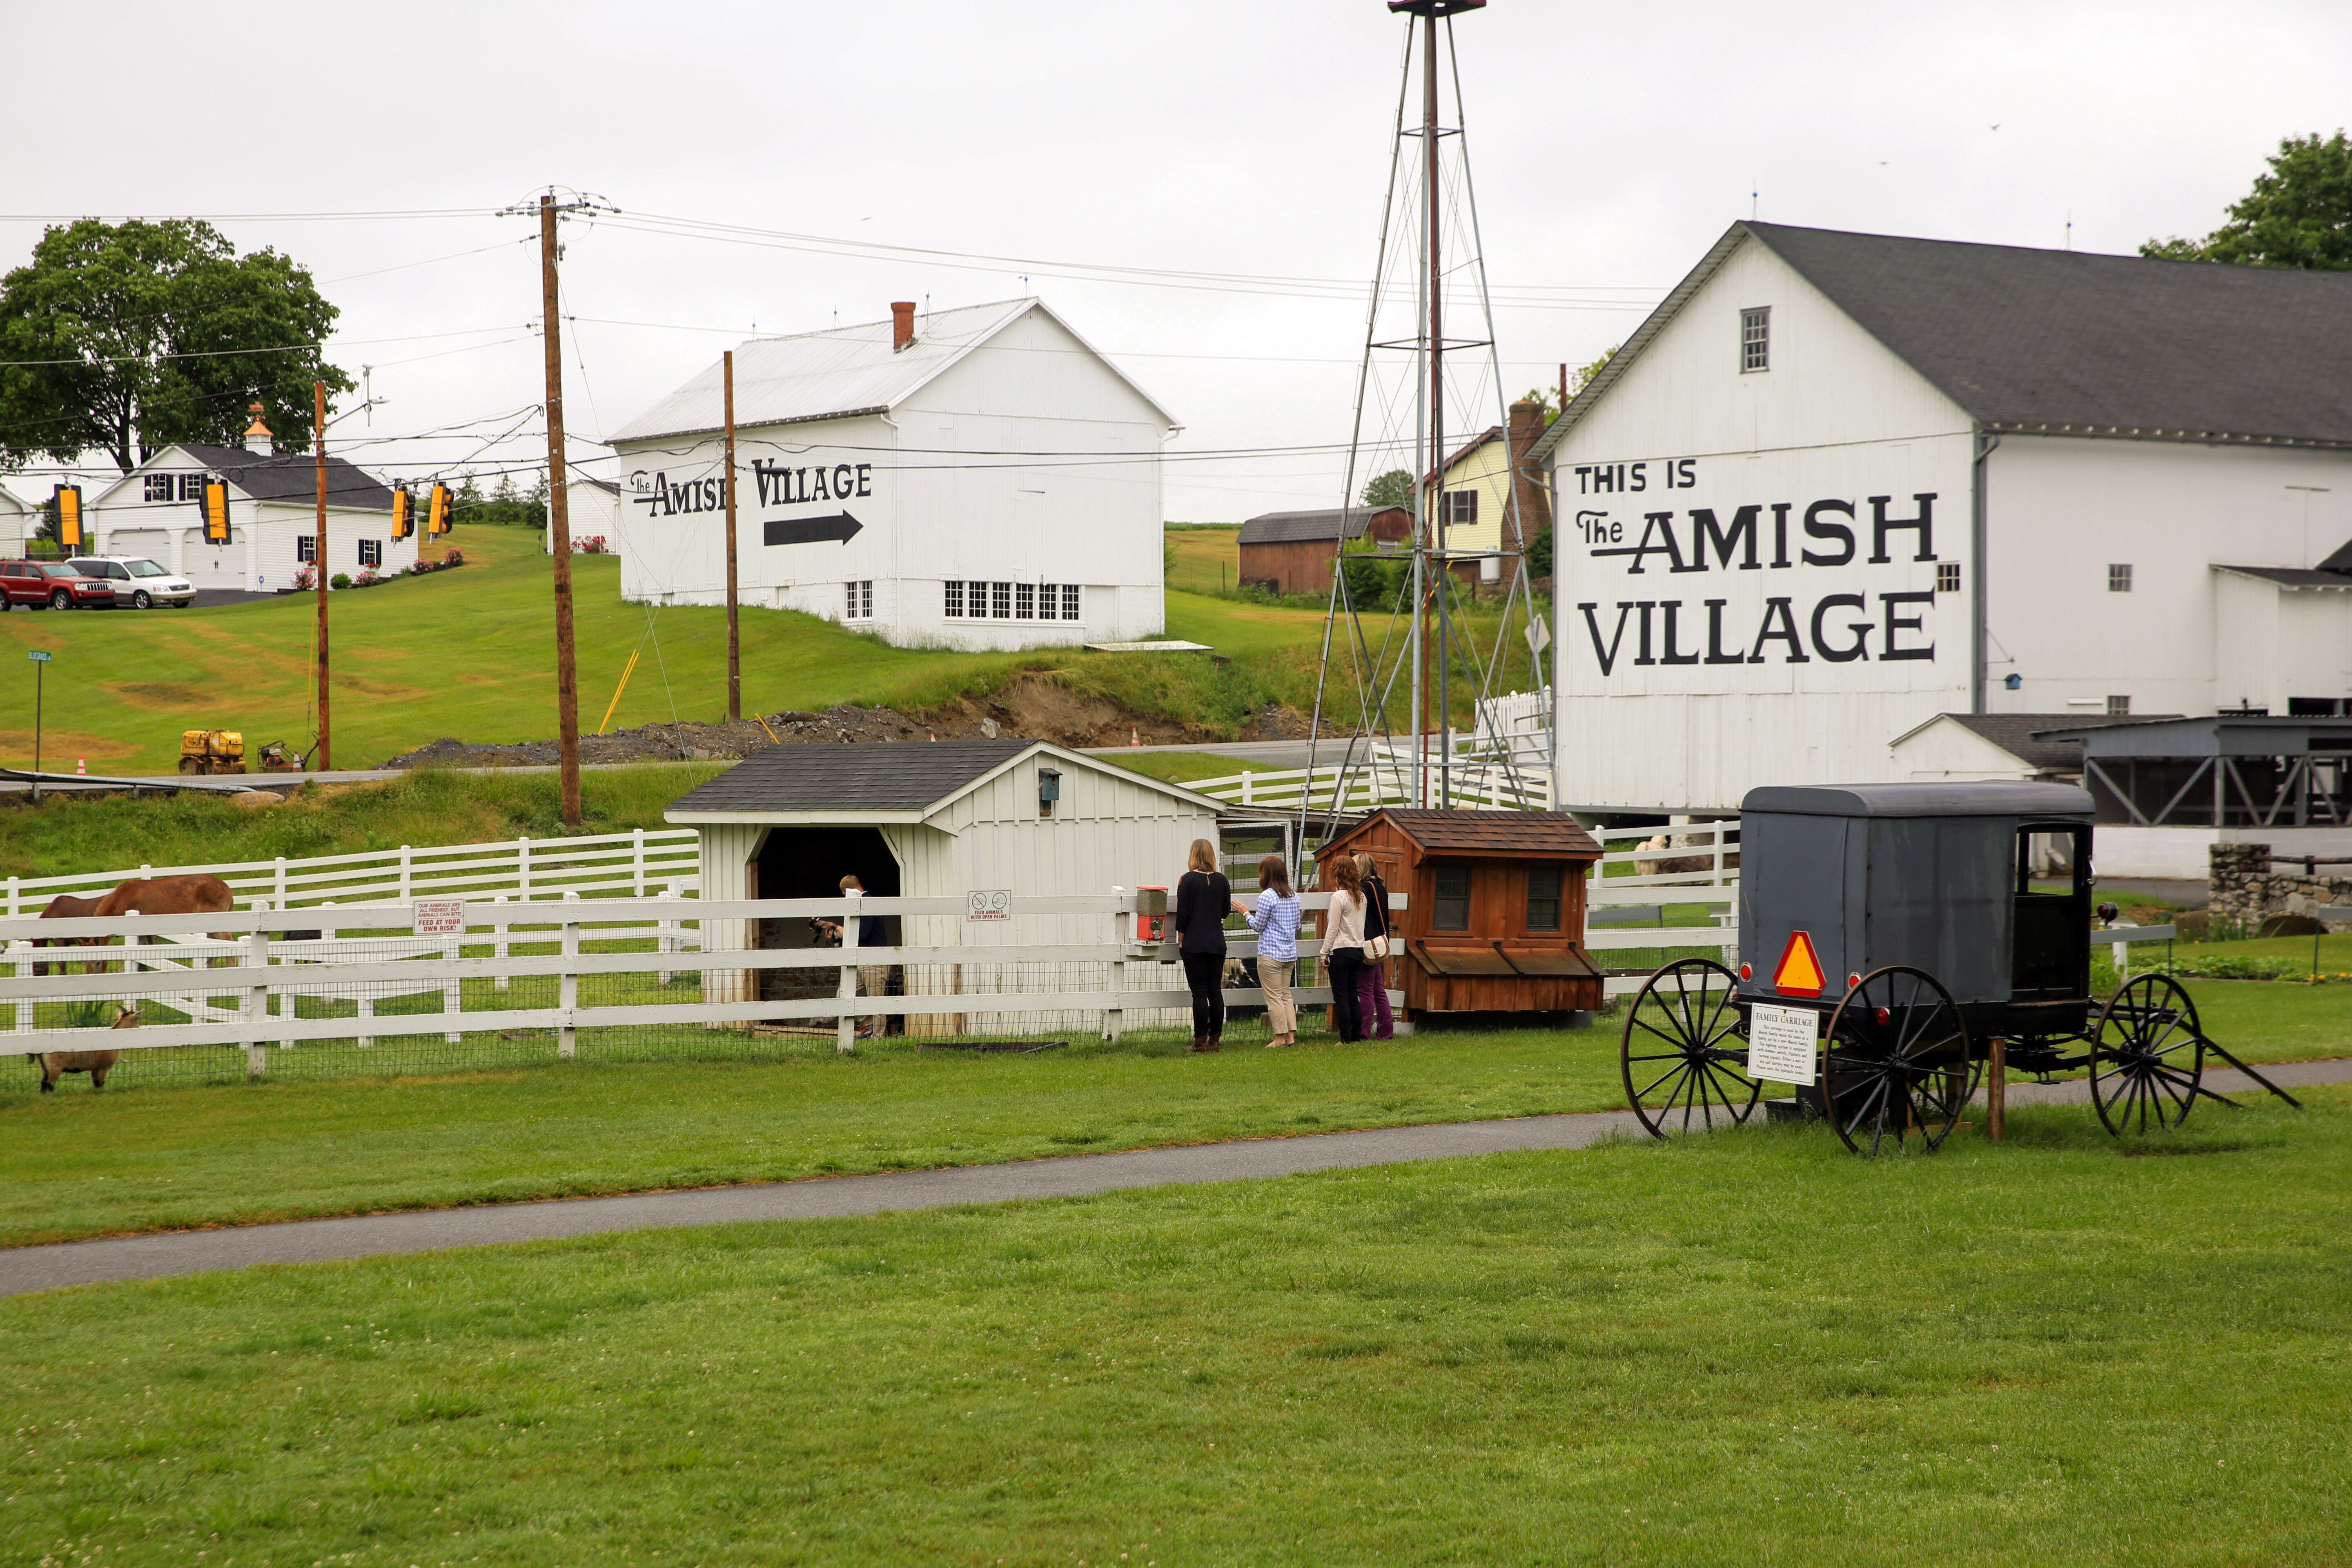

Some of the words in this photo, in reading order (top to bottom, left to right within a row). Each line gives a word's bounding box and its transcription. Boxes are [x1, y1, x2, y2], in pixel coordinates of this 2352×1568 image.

[630, 470, 650, 493] The
[751, 458, 871, 508] VILLAGE
[1575, 463, 1646, 494] THIS
[1667, 459, 1696, 489] IS
[1576, 510, 1623, 544] The
[1590, 492, 1938, 574] AMISH
[1577, 587, 1936, 677] VILLAGE
[29, 652, 47, 660] BLUEGRASS
[1756, 1012, 1779, 1023] FAMILY
[1780, 1016, 1813, 1027] CARRIAGE
